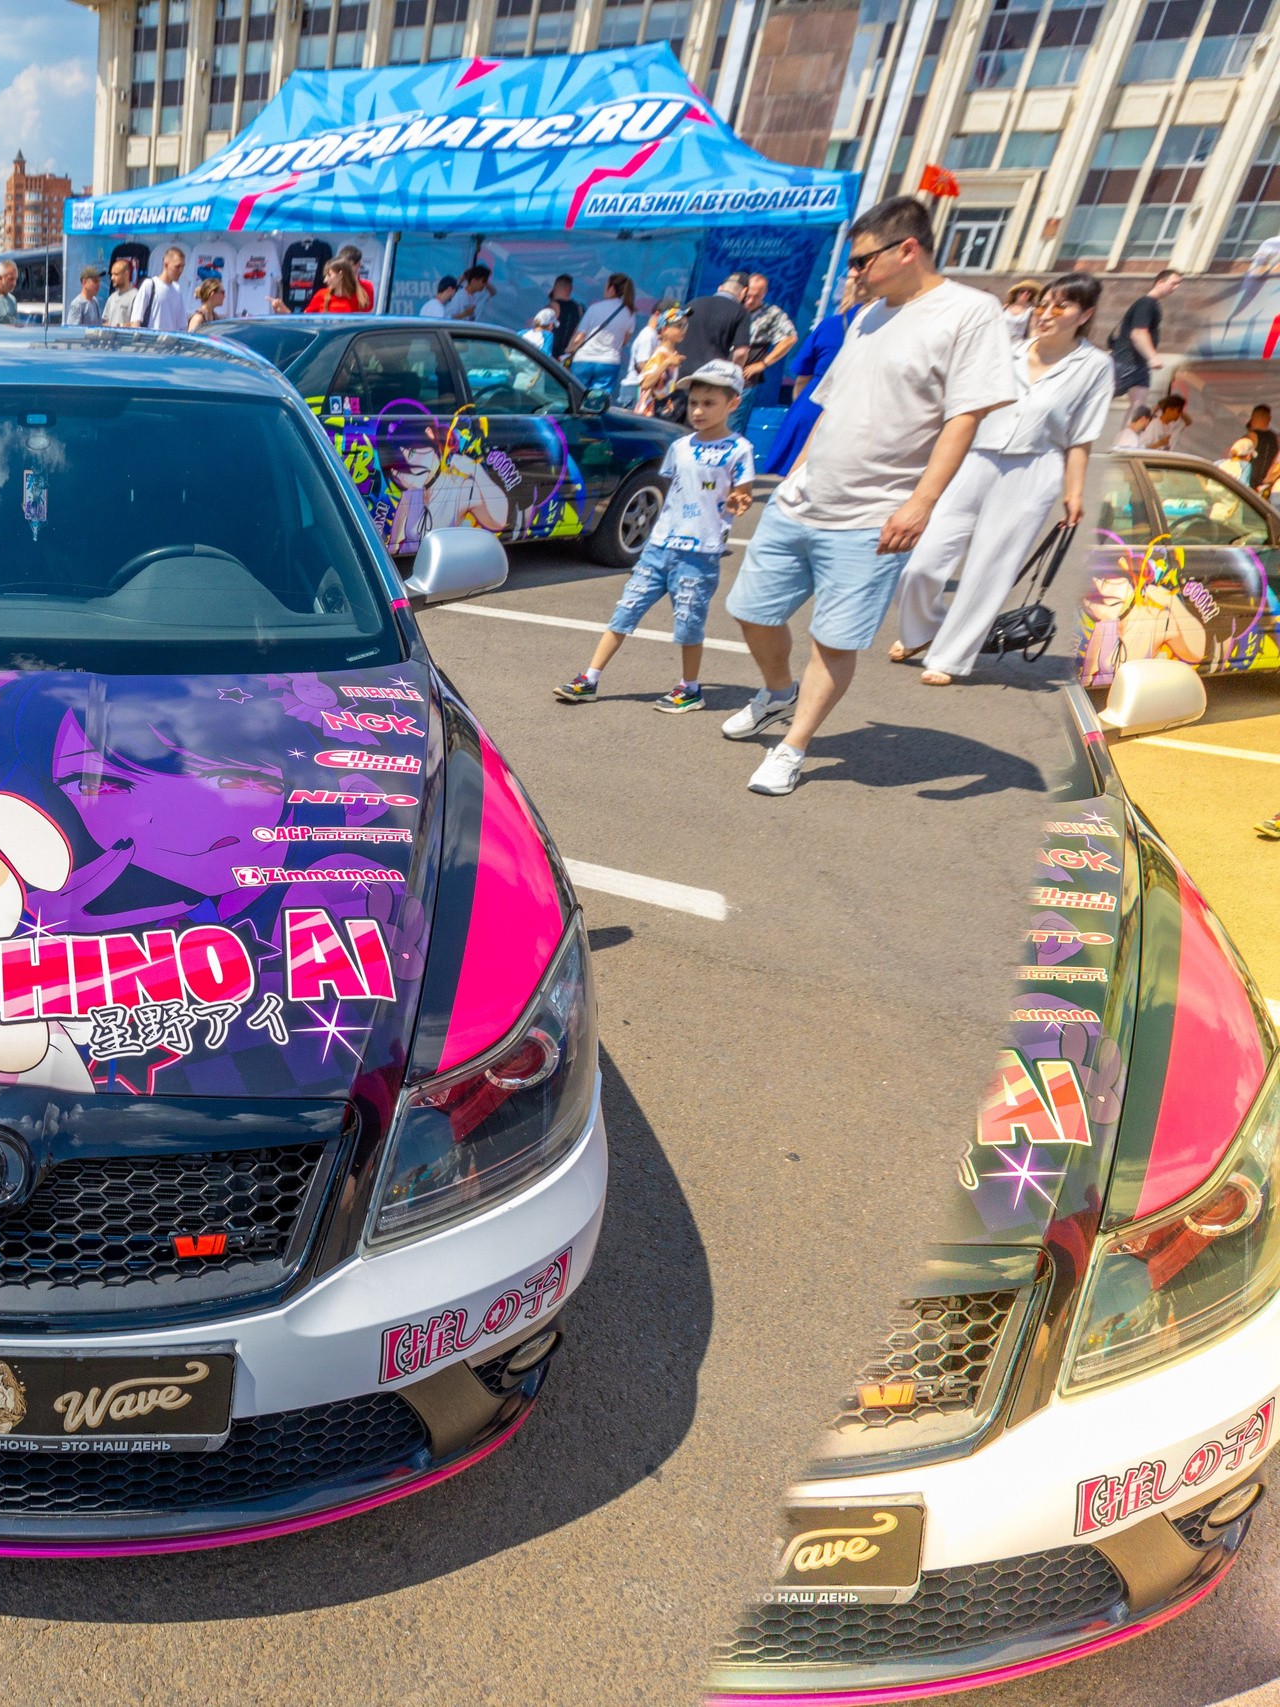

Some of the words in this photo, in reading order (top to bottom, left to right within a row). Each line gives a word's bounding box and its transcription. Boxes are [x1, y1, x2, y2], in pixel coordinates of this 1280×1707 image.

[193, 100, 690, 184] AUTOFANATIC.RU
[586, 192, 688, 216] МАГАЗИН
[685, 186, 840, 213] АВТОФАНАТА
[98, 204, 212, 226] AUTOFANATIC.RU
[486, 449, 522, 492] BOOM!
[1183, 581, 1220, 624] BOOM!
[340, 686, 424, 702] MAHLE
[320, 711, 426, 737] NGK
[314, 750, 422, 773] Eibach
[288, 790, 418, 806] NITTO
[275, 826, 311, 842] AGP
[311, 832, 413, 844] motorsport
[262, 867, 406, 883] Zimmermann
[1014, 970, 1108, 983] otorsport
[88, 993, 289, 1061] 星野アイ
[53, 1360, 210, 1433] Wave
[61, 1440, 89, 1452] ЭТО
[92, 1441, 129, 1452] НАШ
[130, 1440, 171, 1453] ДЕНЬ
[777, 1592, 815, 1603] НАШ
[817, 1592, 859, 1605] ДЕНЬ
